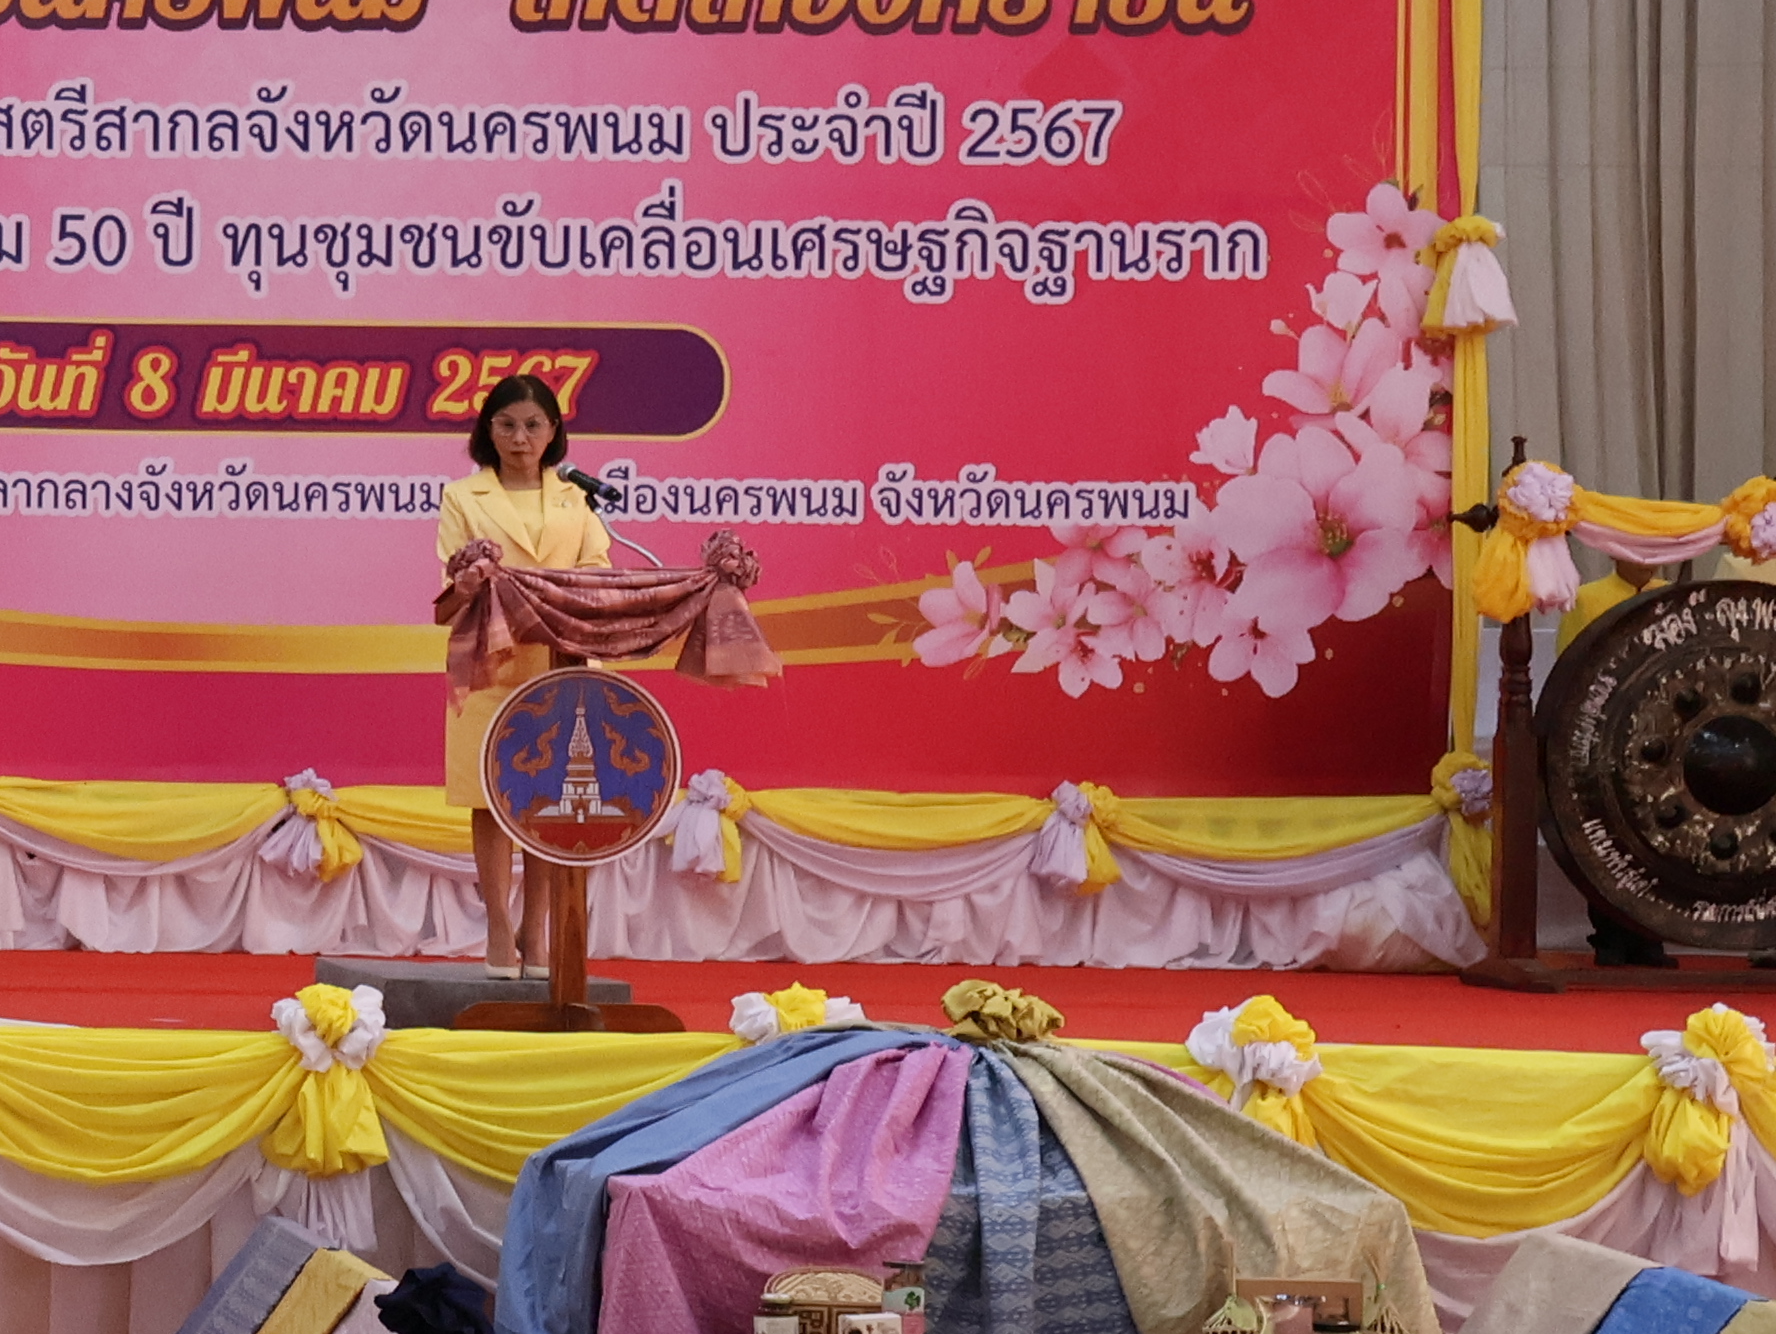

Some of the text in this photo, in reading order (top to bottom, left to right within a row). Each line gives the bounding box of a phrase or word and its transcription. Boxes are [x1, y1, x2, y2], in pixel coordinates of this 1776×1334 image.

[710, 91, 937, 158] ประจำปี
[966, 106, 1117, 159] 2567
[52, 213, 128, 267] 50
[150, 196, 195, 267] ปี
[221, 187, 1265, 297] ทุนชุมชนขับเคลื่อนเศรษฐกิจฐานราก
[130, 352, 173, 413] 8
[200, 349, 405, 416] มีนาคม
[877, 468, 1190, 520] จังหวัดนครพนม
